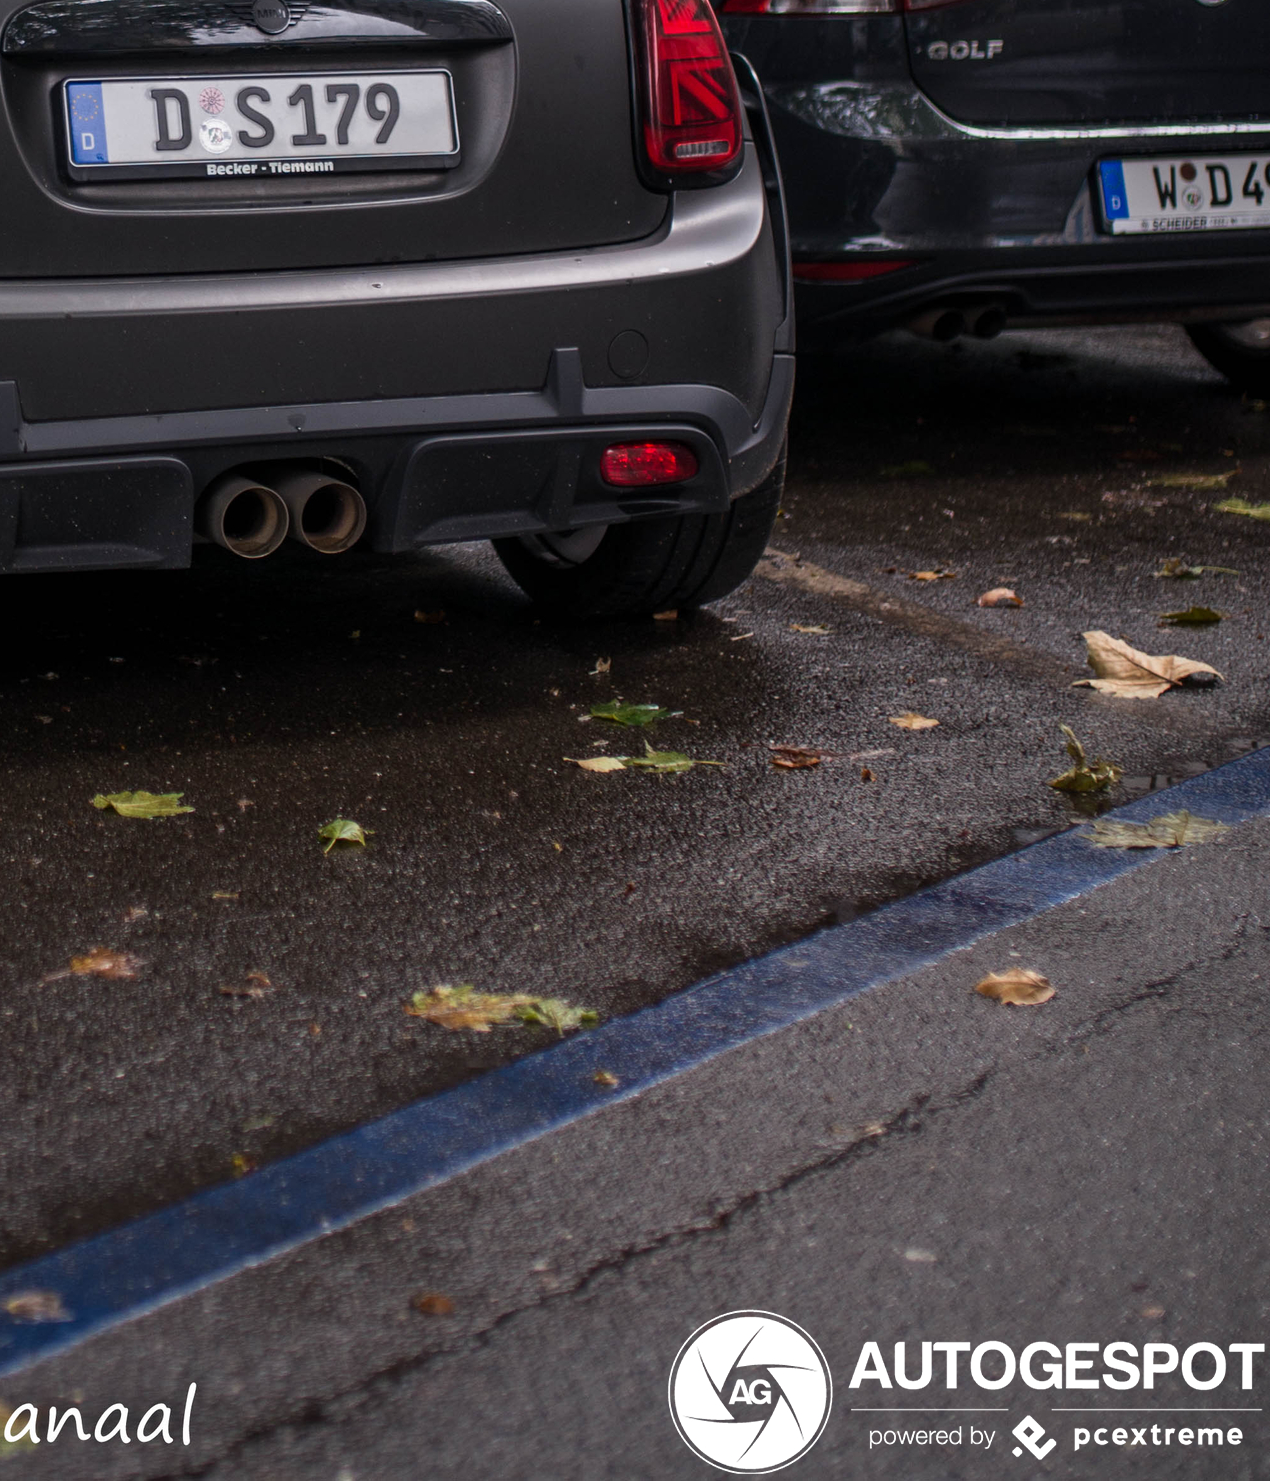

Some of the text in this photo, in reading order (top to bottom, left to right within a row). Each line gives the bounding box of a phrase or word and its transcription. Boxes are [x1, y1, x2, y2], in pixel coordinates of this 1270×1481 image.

[928, 39, 1004, 60] GOLF
[82, 132, 95, 150] D
[150, 88, 192, 151] D
[206, 162, 258, 175] Becker
[269, 160, 334, 174] Tiemann
[1112, 196, 1121, 210] D
[1153, 164, 1178, 210] W
